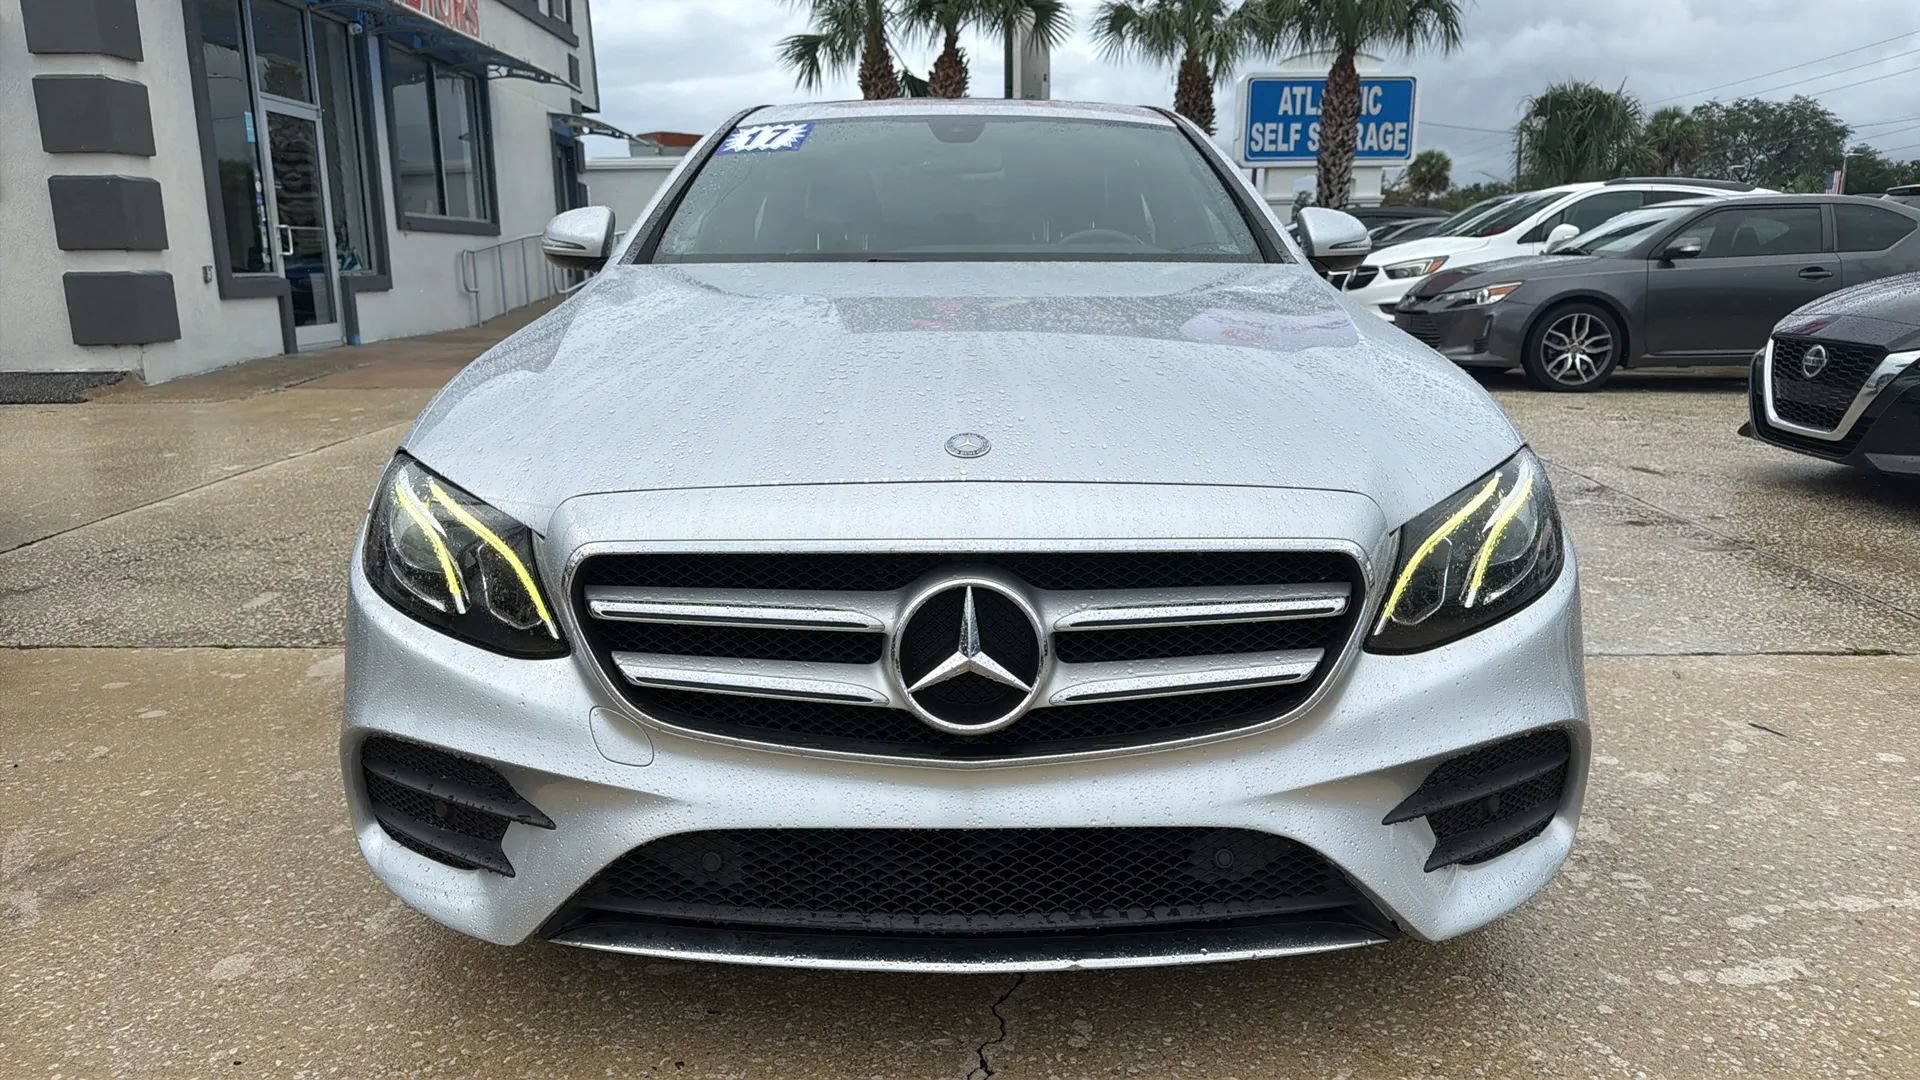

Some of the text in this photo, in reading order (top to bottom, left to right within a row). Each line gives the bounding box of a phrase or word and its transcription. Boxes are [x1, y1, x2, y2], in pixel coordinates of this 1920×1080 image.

[1278, 86, 1383, 115] ATLIC
[744, 129, 790, 146] 17
[1251, 122, 1408, 152] SELF SRAGE
